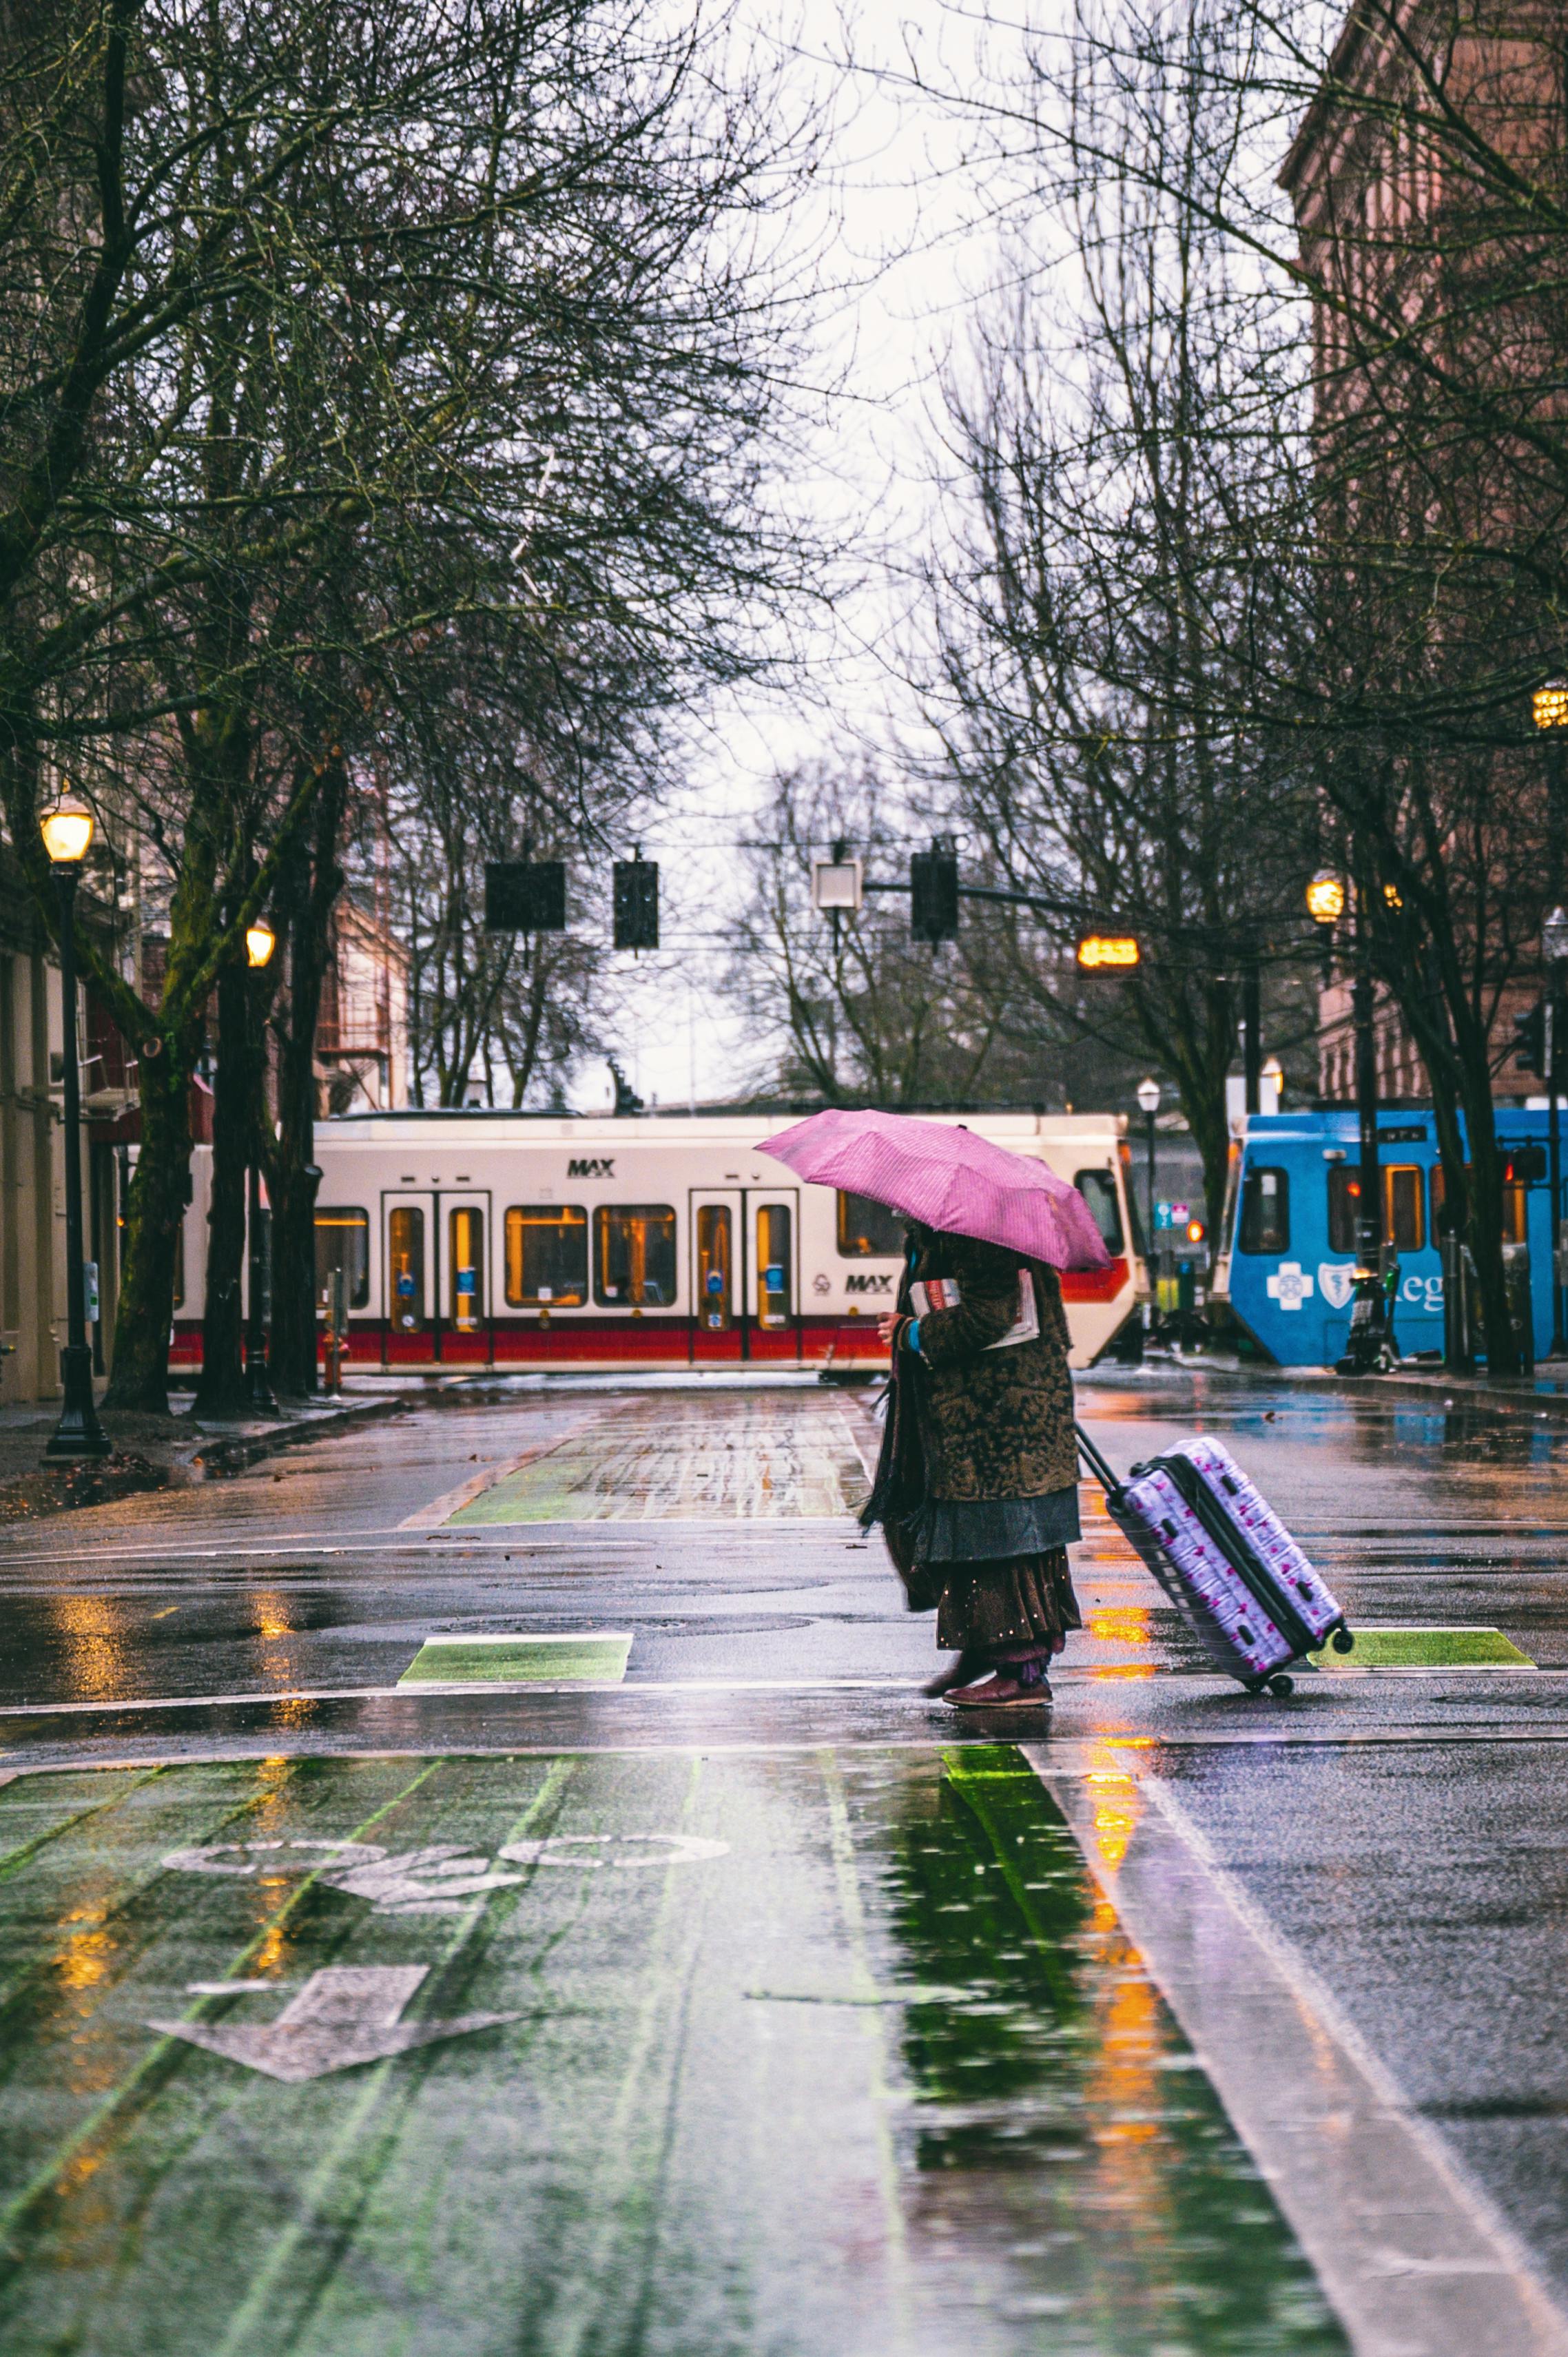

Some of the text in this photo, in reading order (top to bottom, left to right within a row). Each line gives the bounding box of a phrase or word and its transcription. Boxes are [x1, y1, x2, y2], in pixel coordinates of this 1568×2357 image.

[567, 1159, 615, 1178] MAX
[845, 1275, 893, 1294] MAX
[1395, 1276, 1445, 1312] eg
